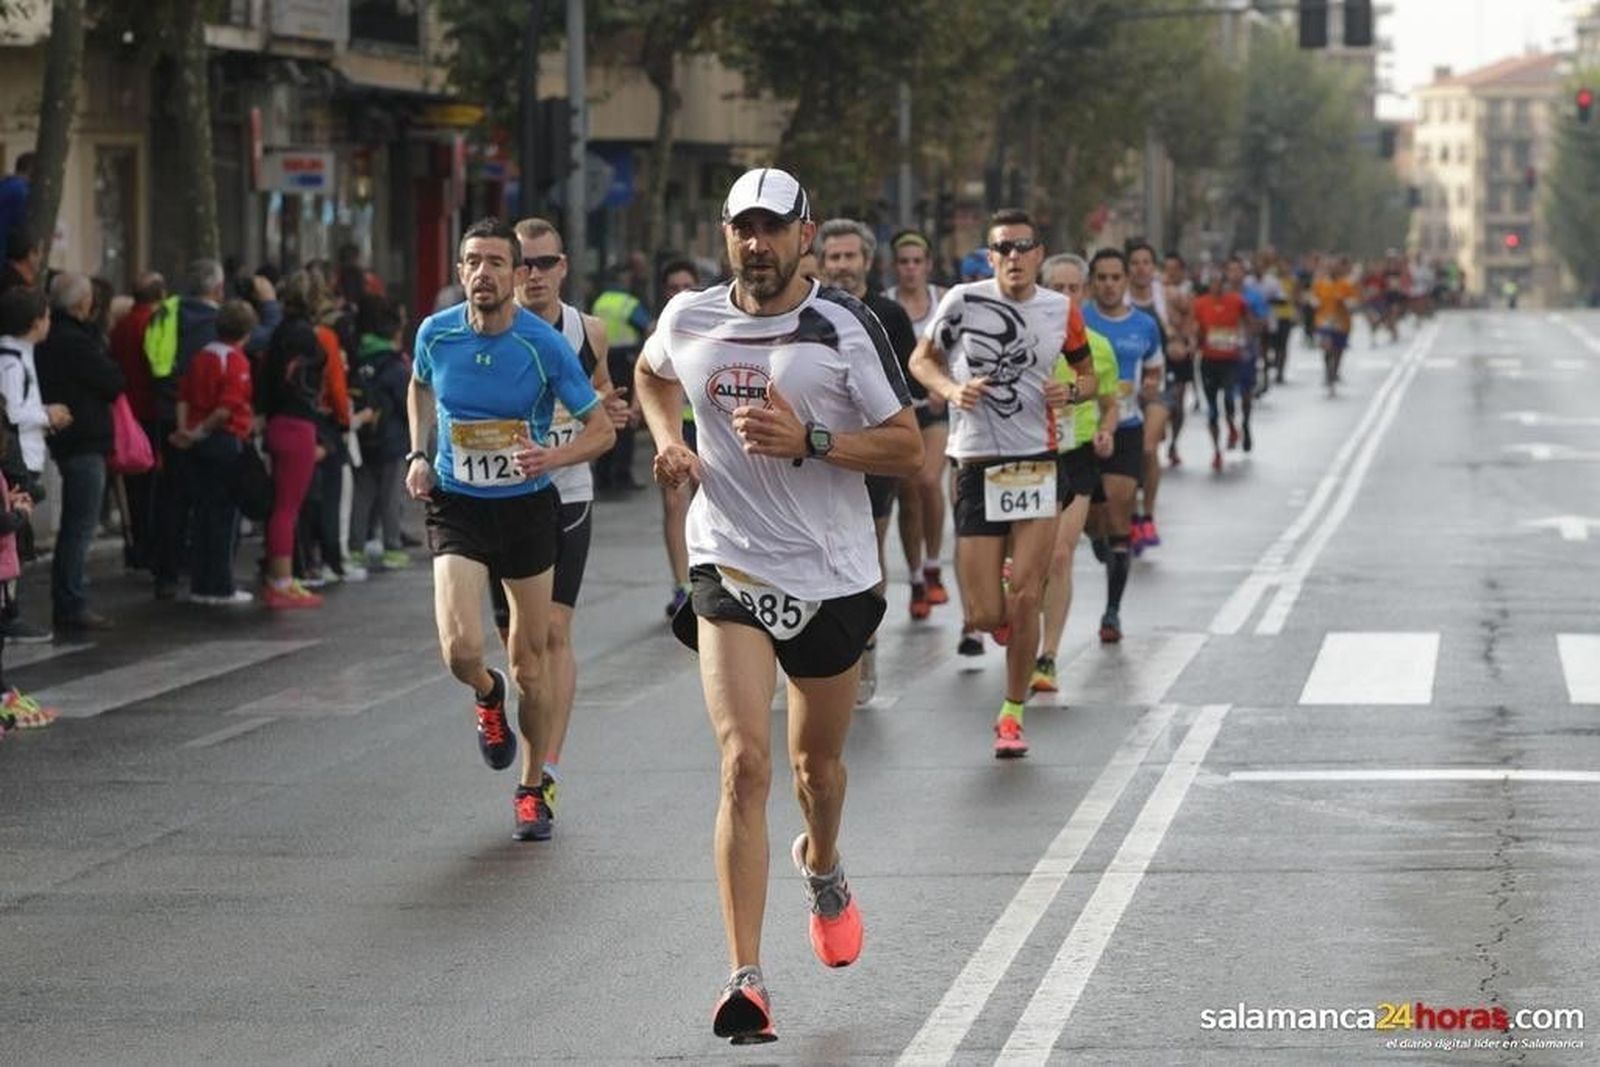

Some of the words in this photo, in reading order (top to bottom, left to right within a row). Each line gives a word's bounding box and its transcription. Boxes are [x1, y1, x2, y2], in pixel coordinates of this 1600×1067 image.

[462, 455, 520, 481] 112
[1000, 490, 1041, 513] 641
[740, 590, 802, 629] 985
